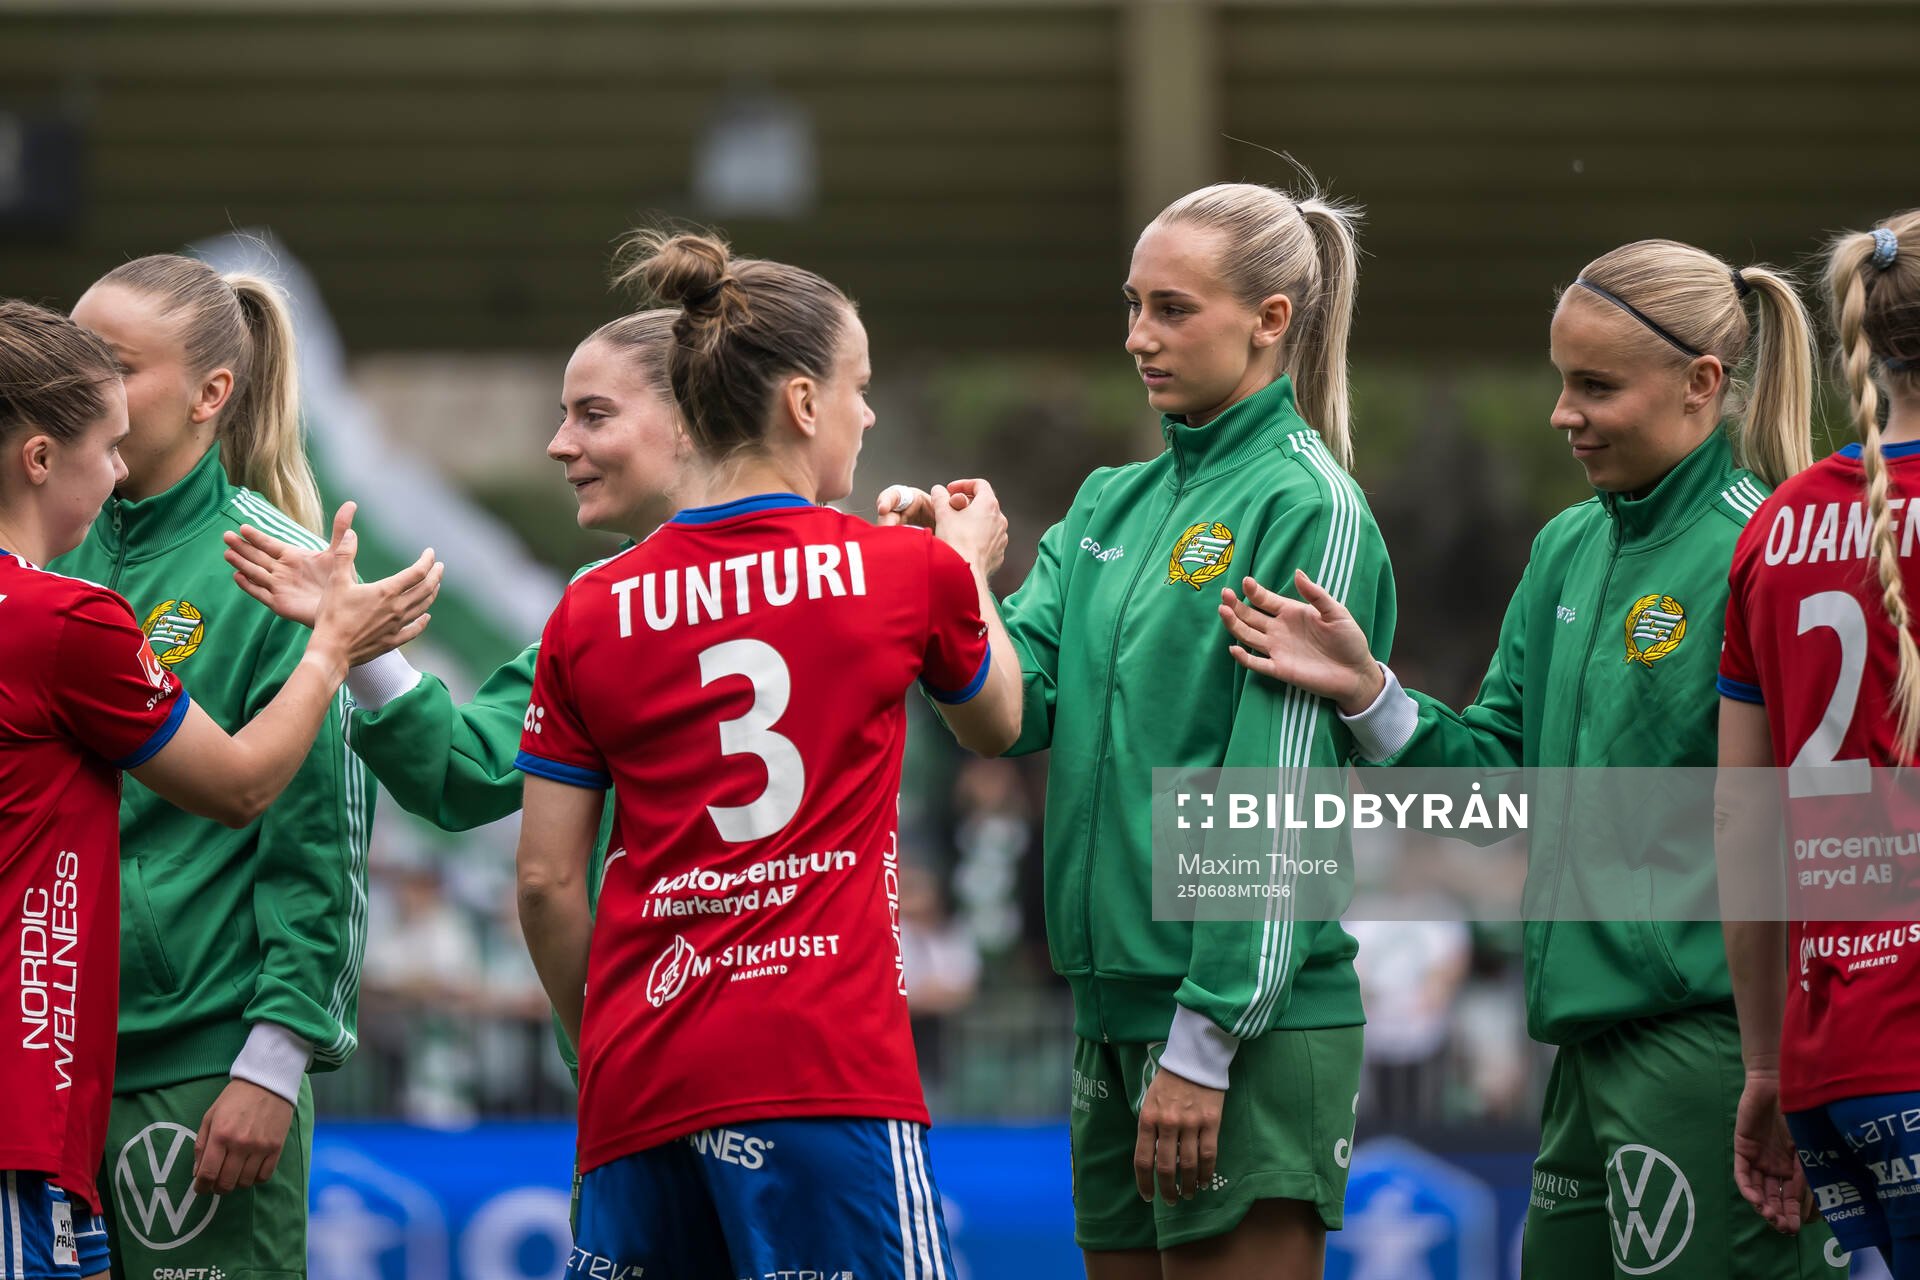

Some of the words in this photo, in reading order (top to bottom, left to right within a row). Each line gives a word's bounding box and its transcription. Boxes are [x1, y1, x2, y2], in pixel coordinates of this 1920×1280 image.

[610, 541, 867, 638] TUNTURI
[1788, 590, 1872, 798] 2
[698, 638, 806, 844] 3
[1862, 864, 1893, 884] AB
[641, 900, 650, 918] i
[653, 890, 760, 918] Markaryd
[762, 884, 797, 906] AB
[20, 887, 49, 1050] NORDIC
[52, 850, 79, 1091] WELLNESS
[691, 935, 839, 977] MSIKHUSET
[730, 964, 788, 982] MARKARYD
[1848, 955, 1898, 972] MARKARYD
[152, 1267, 209, 1280] CRAFT
